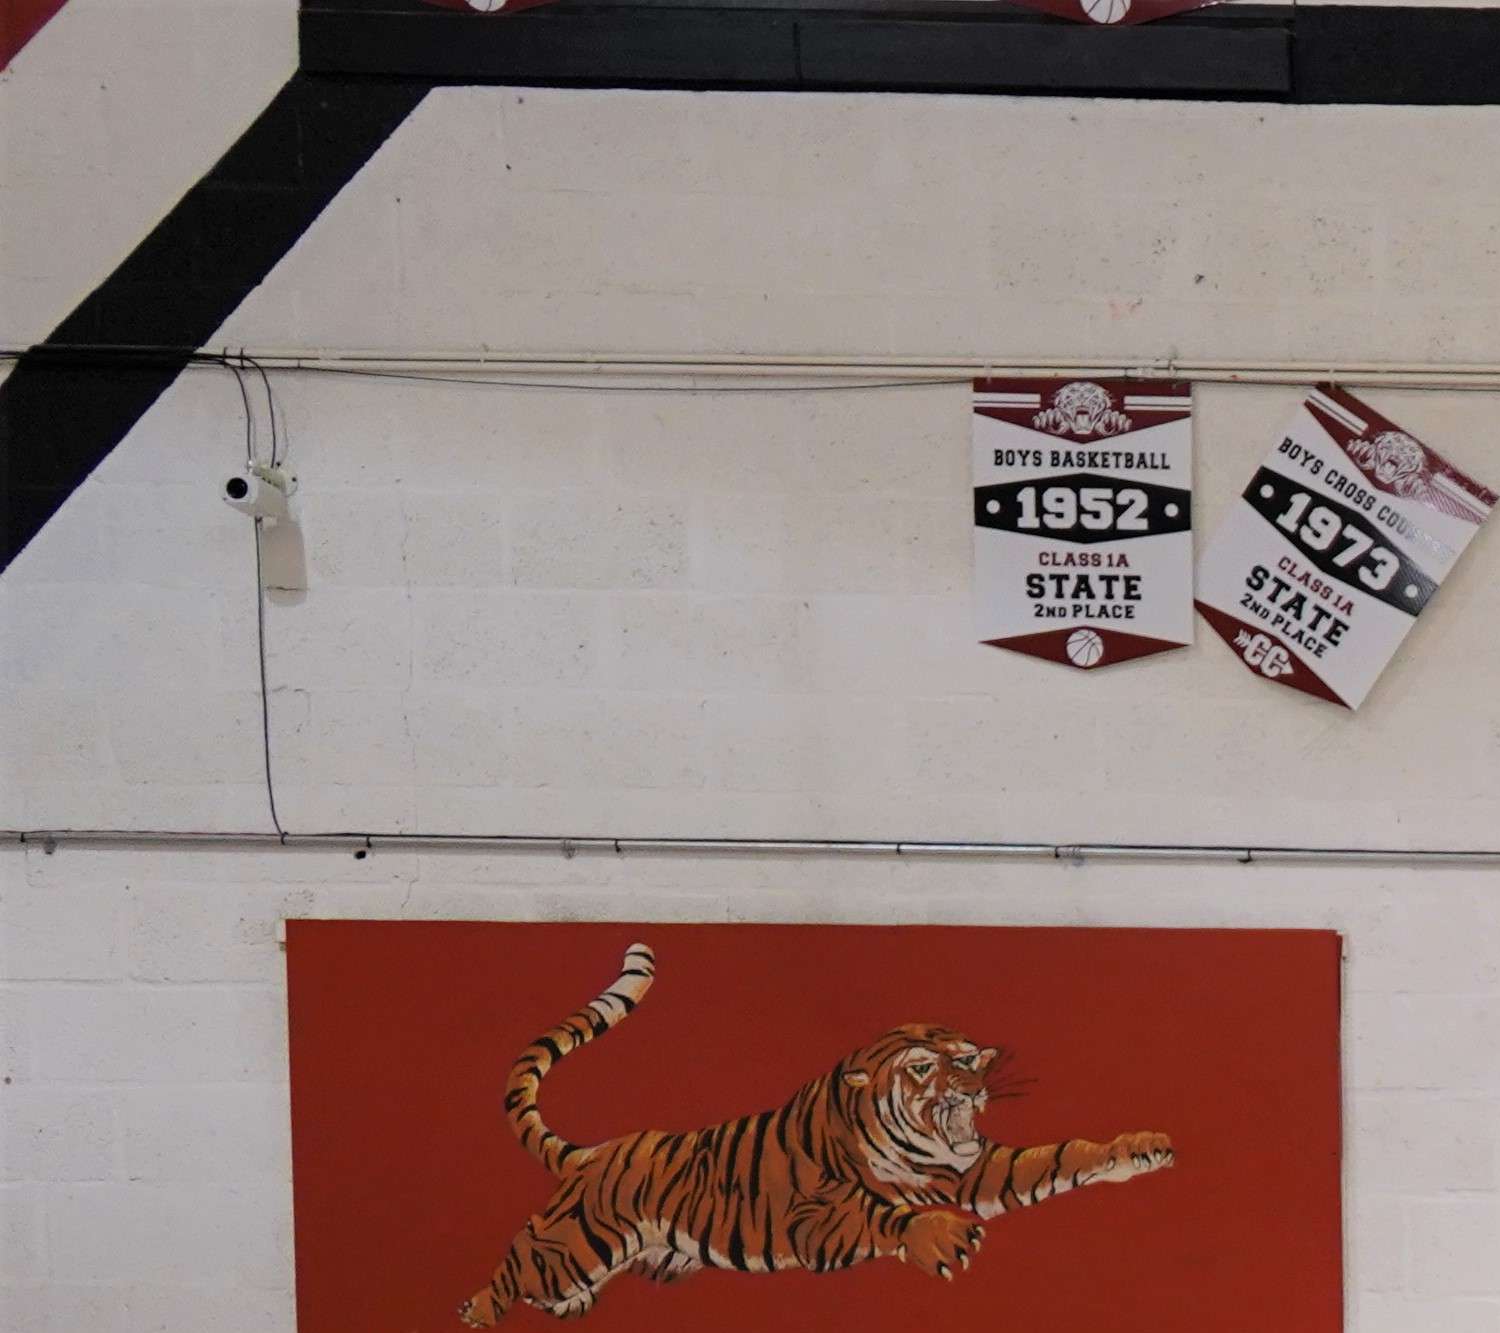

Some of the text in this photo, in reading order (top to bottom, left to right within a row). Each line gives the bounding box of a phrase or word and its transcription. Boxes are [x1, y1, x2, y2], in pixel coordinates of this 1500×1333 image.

[994, 449, 1171, 470] BOYS BASKETBALL
[1278, 437, 1376, 511] BOYS CROSS
[1016, 487, 1149, 530] 1952
[1038, 552, 1130, 568] CLASS 1A
[1276, 492, 1404, 591] 1973
[1026, 573, 1142, 600] STATE
[1245, 565, 1351, 648] STATE
[1277, 556, 1356, 616] CLASS 1A
[1072, 604, 1135, 619] PLACE
[1270, 611, 1330, 659] PLACE
